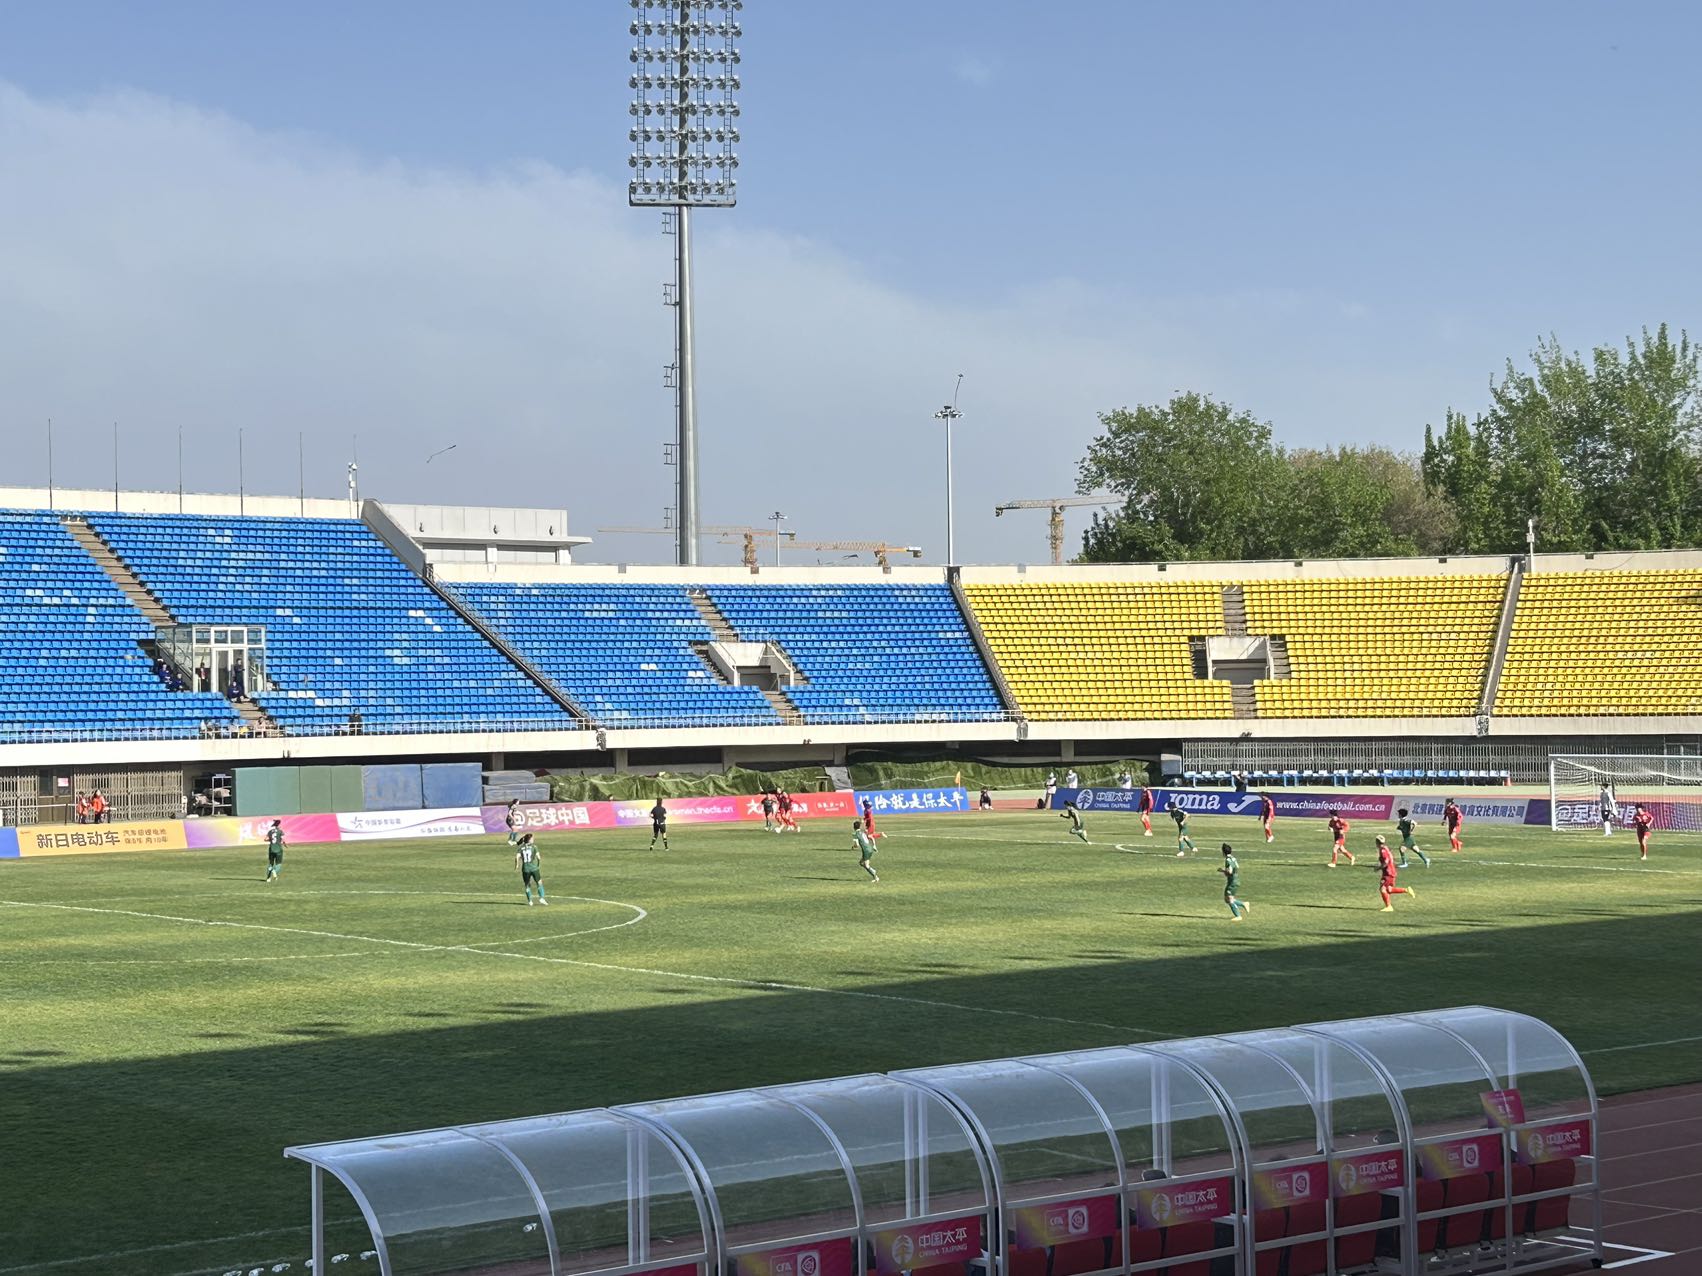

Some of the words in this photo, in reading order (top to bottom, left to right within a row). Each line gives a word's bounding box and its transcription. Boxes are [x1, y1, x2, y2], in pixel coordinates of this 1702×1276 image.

[1096, 791, 1134, 802] 中国太平
[1276, 800, 1386, 812] www.chinafootball.com.cn
[36, 830, 121, 849] 新日电动车
[1174, 1187, 1218, 1206] 中国太平
[918, 1227, 967, 1248] 中国太平
[941, 1243, 968, 1256] TAIPING
